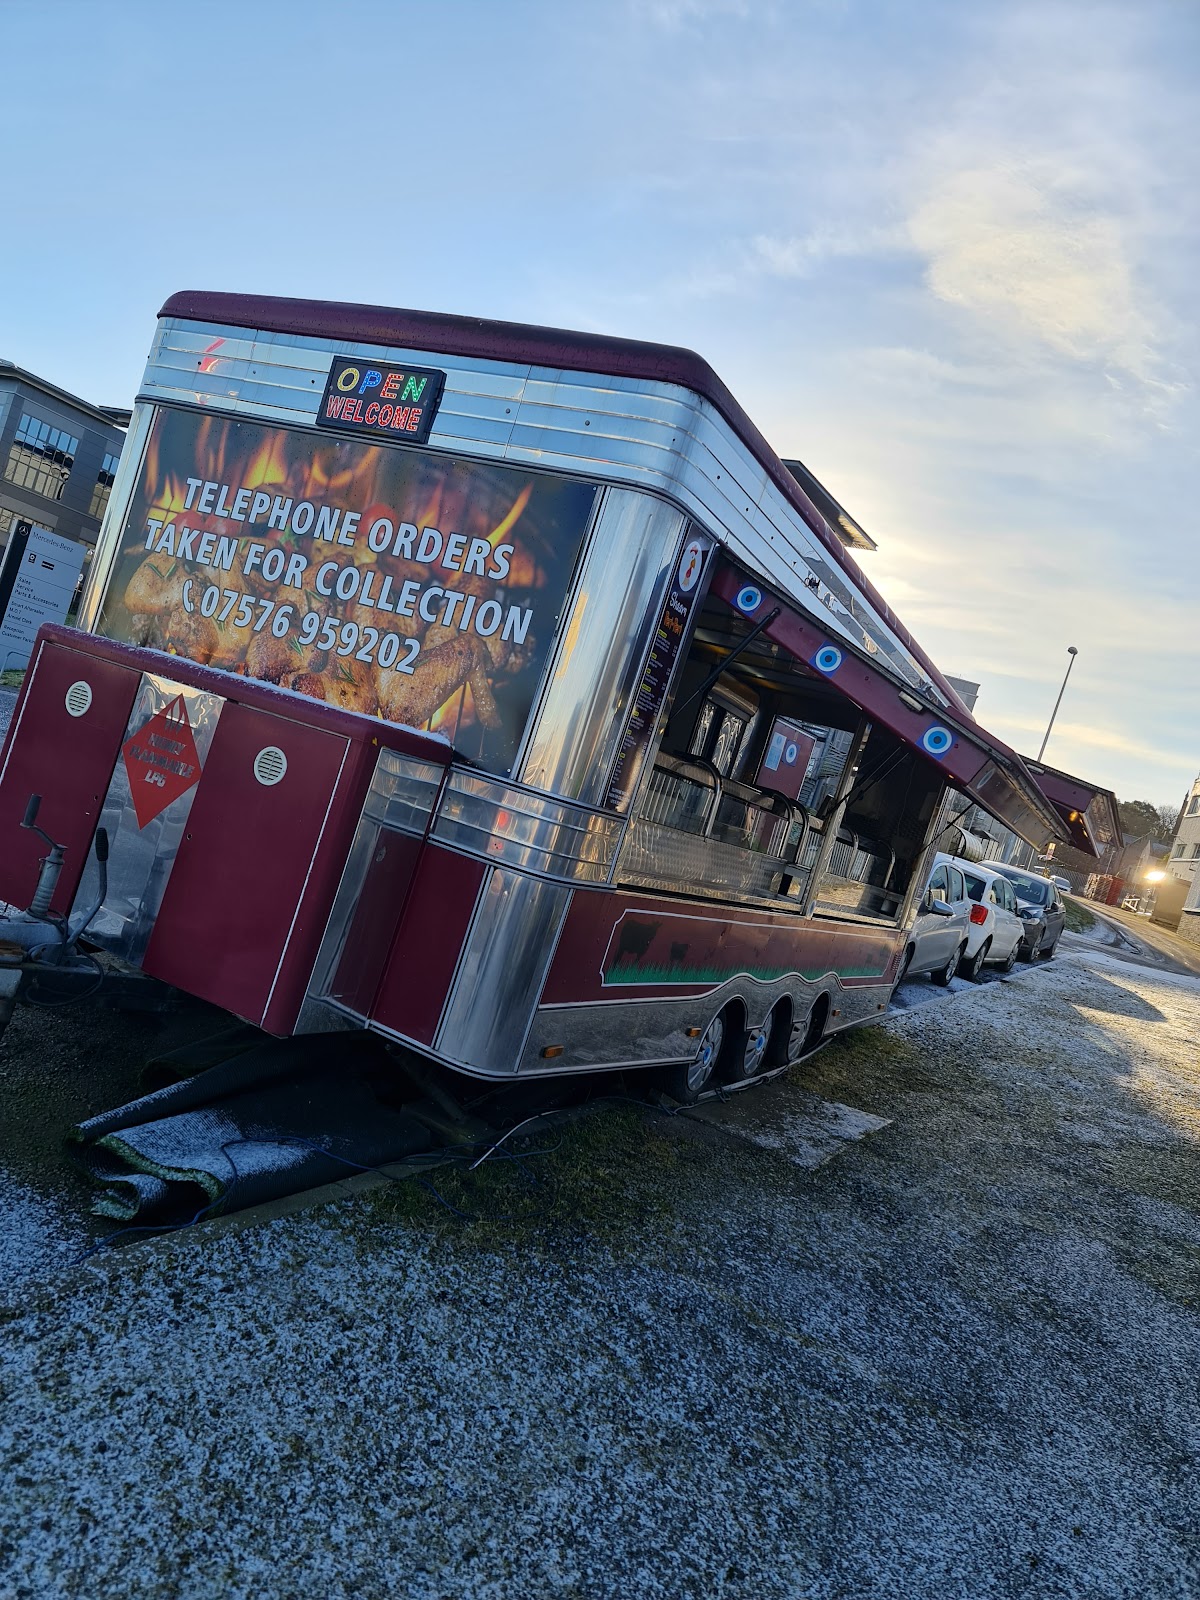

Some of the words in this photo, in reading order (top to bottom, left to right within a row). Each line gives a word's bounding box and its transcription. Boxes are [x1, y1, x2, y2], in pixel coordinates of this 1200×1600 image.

[337, 367, 428, 402] OPEN
[326, 394, 422, 432] WELCOME
[32, 531, 74, 553] Mercedes-Benz
[184, 477, 362, 546] TELEPHONE
[368, 517, 515, 581] ORDERS
[16, 583, 34, 593] Service
[18, 576, 31, 586] Sales
[144, 518, 237, 571] TAKEN
[244, 543, 309, 590] FOR
[315, 560, 533, 645] COLLECTION
[14, 589, 27, 598] Parts
[32, 595, 59, 608] Accessories
[200, 587, 293, 639] 07576
[299, 613, 421, 676] 959202
[144, 769, 167, 788] LPG
